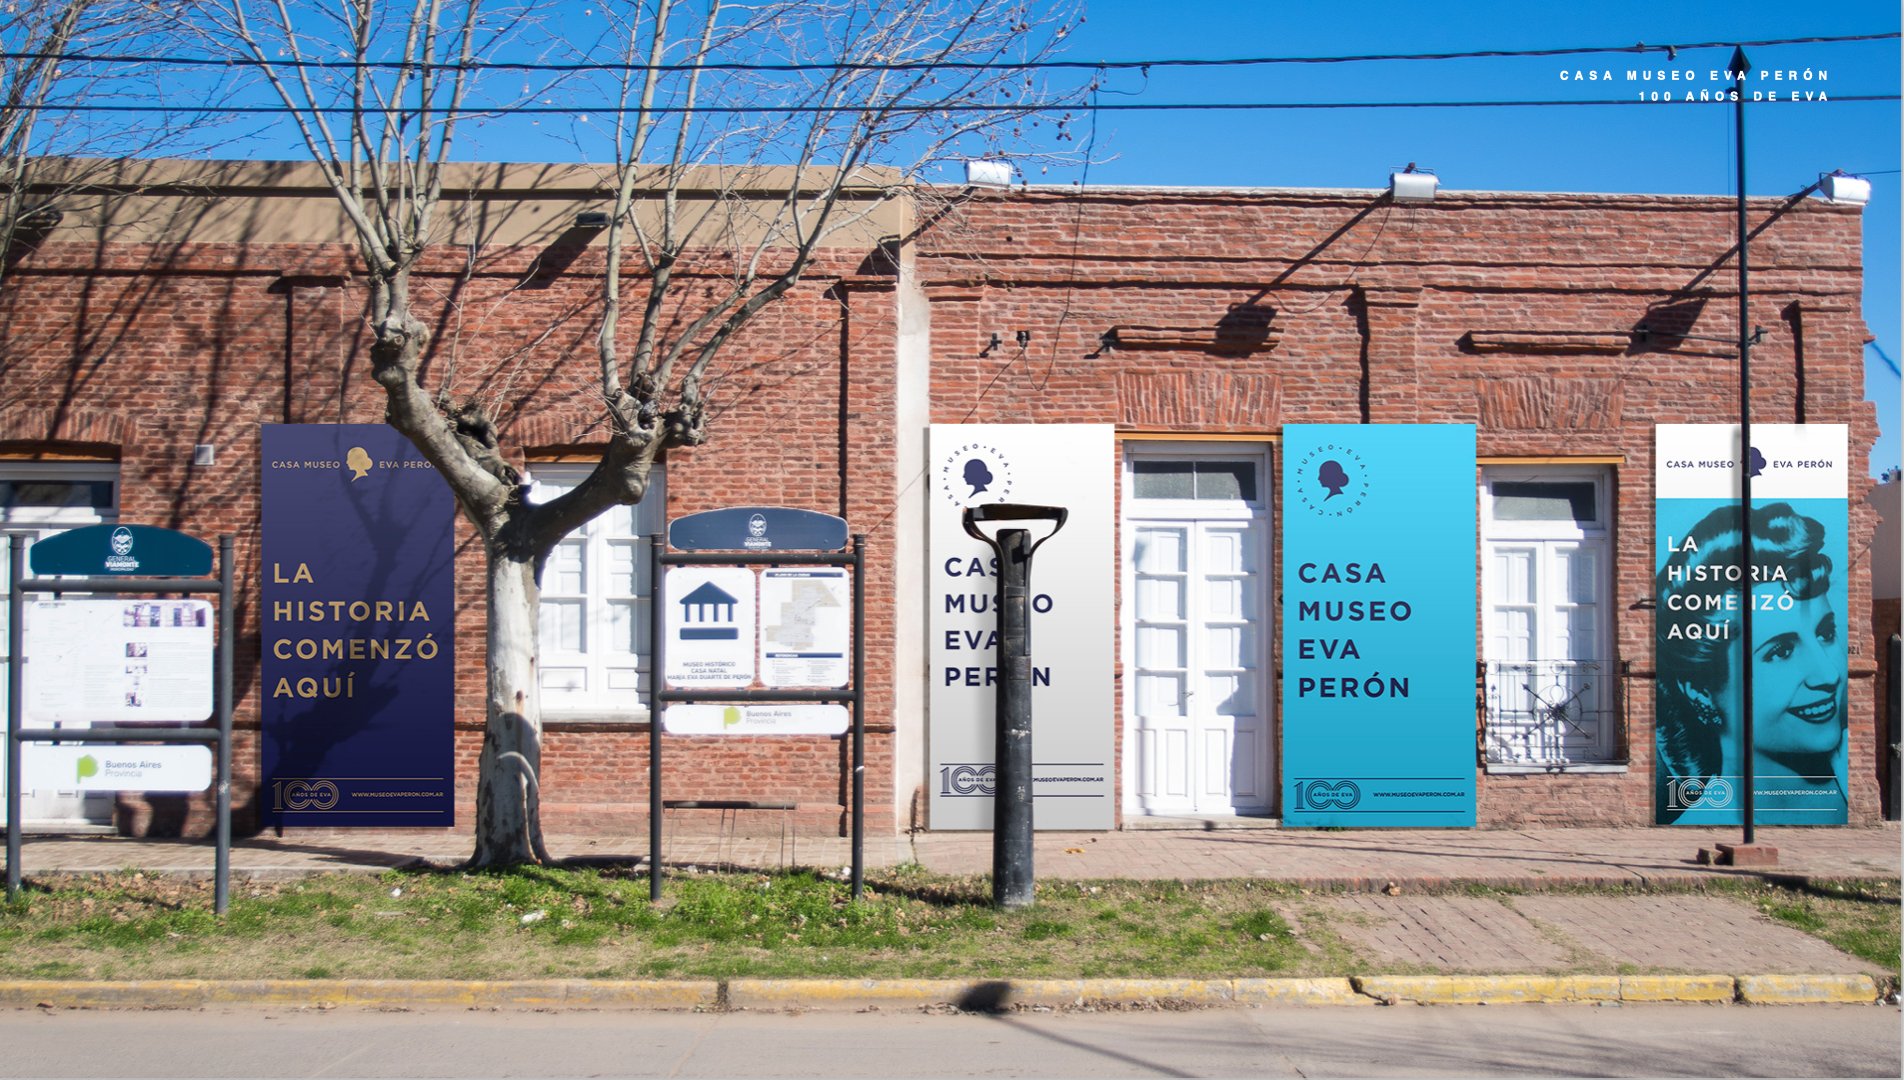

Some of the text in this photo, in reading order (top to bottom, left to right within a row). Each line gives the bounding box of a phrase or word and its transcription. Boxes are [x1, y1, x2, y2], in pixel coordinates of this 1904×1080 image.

[271, 460, 435, 469] CASA MUSEO EVA PERO
[1666, 457, 1833, 468] CASA MUSEO EVA PERÓN
[1668, 536, 1698, 552] LA
[274, 563, 314, 584] LA
[944, 557, 998, 577] CAS
[1298, 562, 1386, 584] CASA
[1668, 565, 1788, 581] HISTORIA
[274, 601, 430, 622] HISTORIA
[945, 594, 1053, 613] MUO
[1299, 600, 1412, 623] MUSEO
[1667, 619, 1730, 640] AQUÍ
[273, 633, 438, 660] COMENZÓ
[1299, 639, 1361, 660] EVA
[273, 672, 355, 698] AQUÍ
[945, 666, 1051, 687] PERN
[1299, 671, 1409, 698] PERÓN
[105, 760, 162, 769] Buenos Aires
[105, 769, 143, 778] Provincia
[272, 780, 340, 811] 100
[1294, 780, 1362, 811] 100
[1666, 778, 1734, 808] 100
